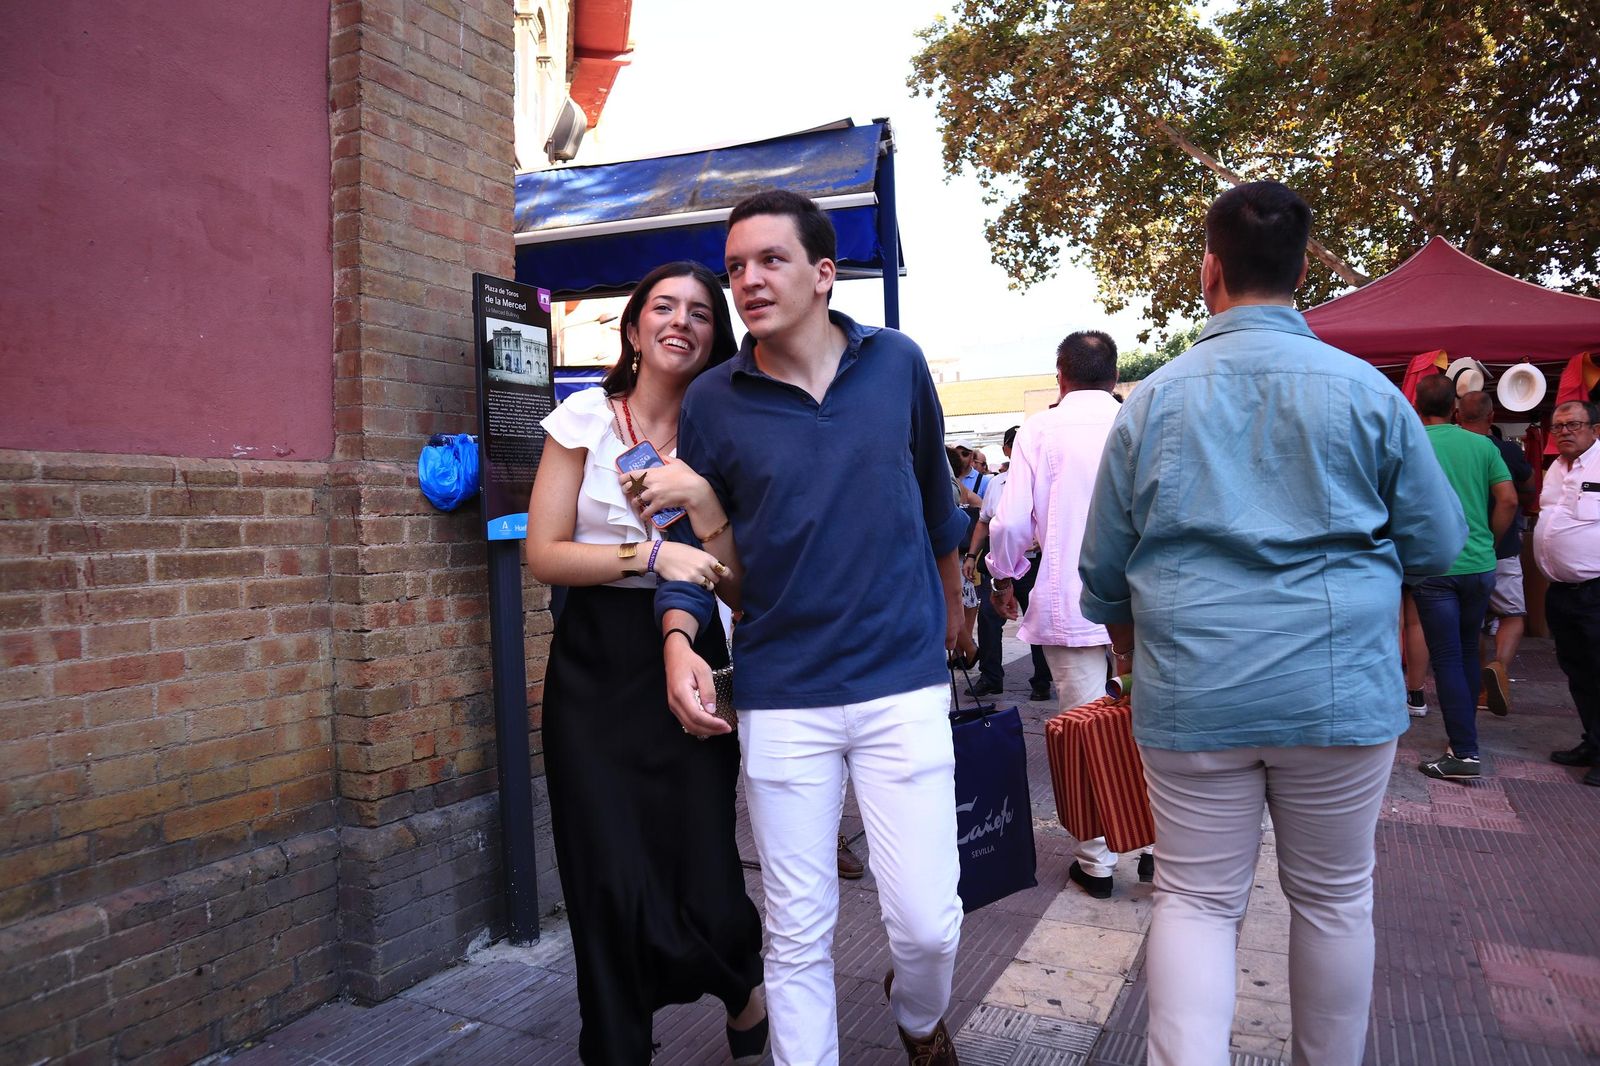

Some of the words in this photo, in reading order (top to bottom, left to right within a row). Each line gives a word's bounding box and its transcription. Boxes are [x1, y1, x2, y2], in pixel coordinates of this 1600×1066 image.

[484, 284, 498, 293] Plaza
[506, 289, 519, 297] Toros
[485, 295, 494, 304] de
[495, 297, 501, 306] la
[502, 299, 527, 311] Merced
[971, 845, 995, 858] SEVILLA
